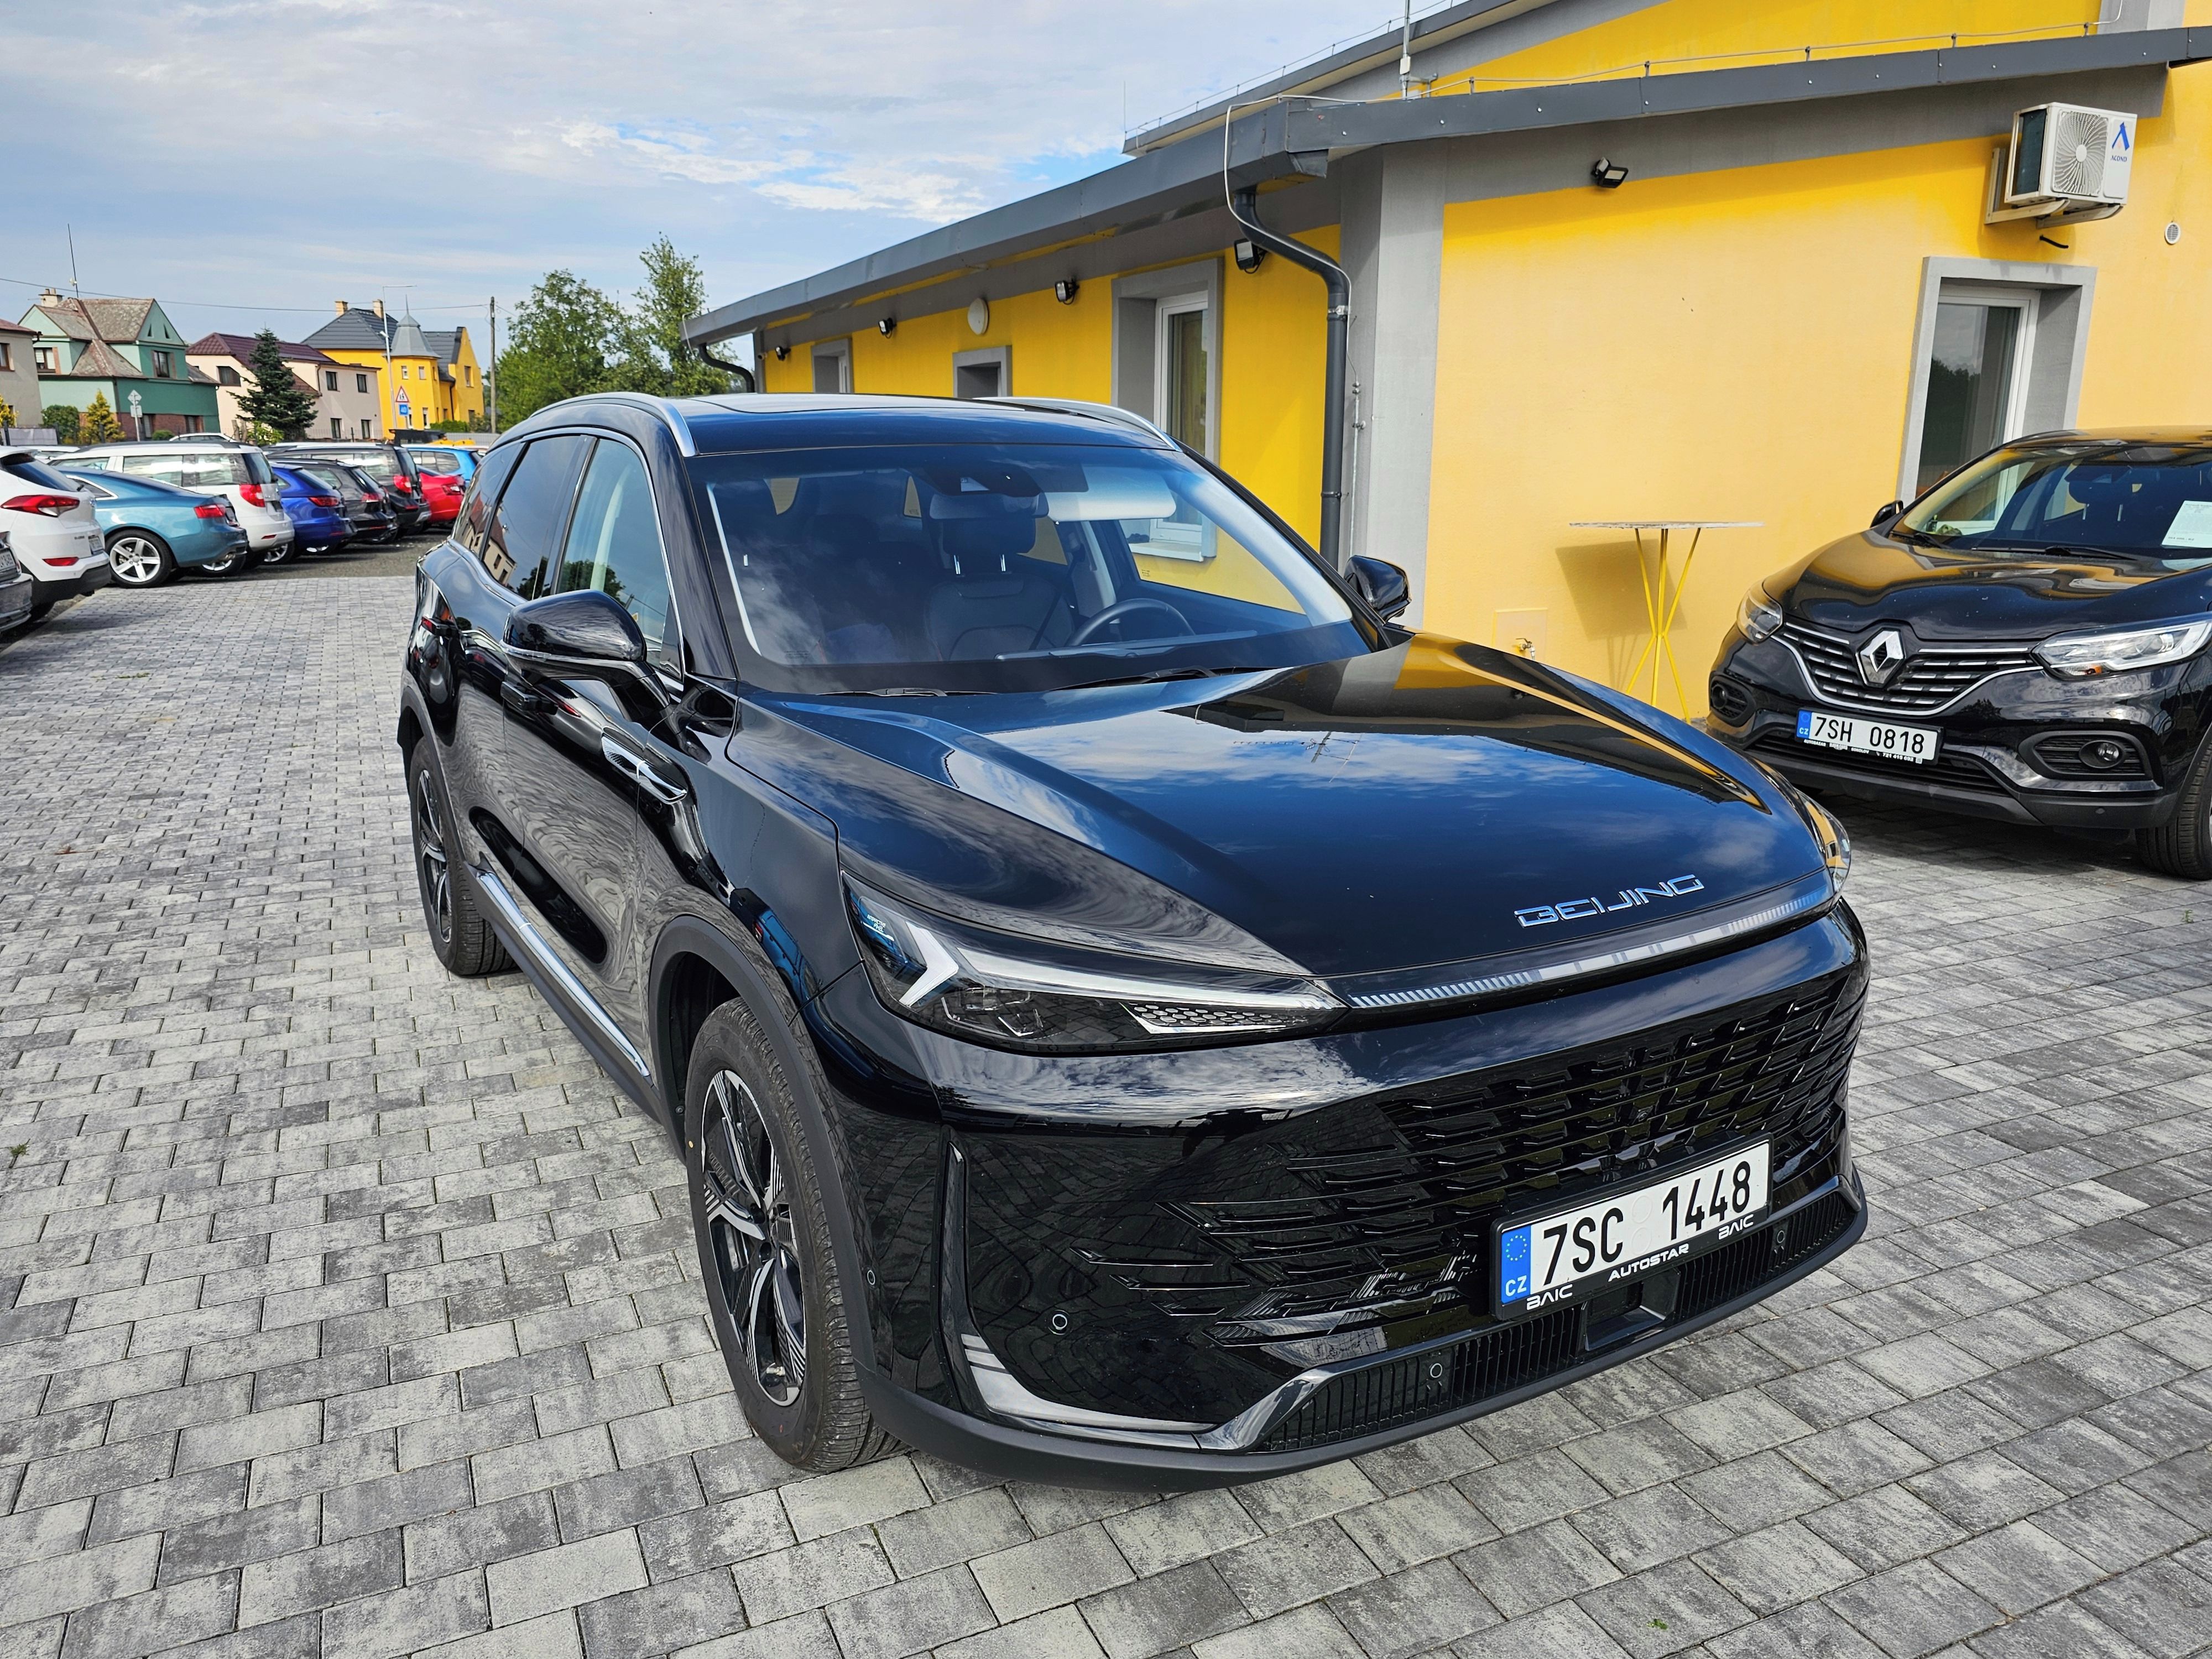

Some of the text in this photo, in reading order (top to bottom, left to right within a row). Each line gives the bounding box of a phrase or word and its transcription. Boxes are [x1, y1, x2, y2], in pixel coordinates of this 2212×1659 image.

[1814, 717, 1924, 754] 7SH 0818
[1514, 874, 1704, 927] BEIJING
[1543, 1161, 1750, 1285] 7SC 1448
[1505, 1276, 1527, 1296] CZ
[1526, 1214, 1754, 1310] BAIC AUTOSTAR BAIC
